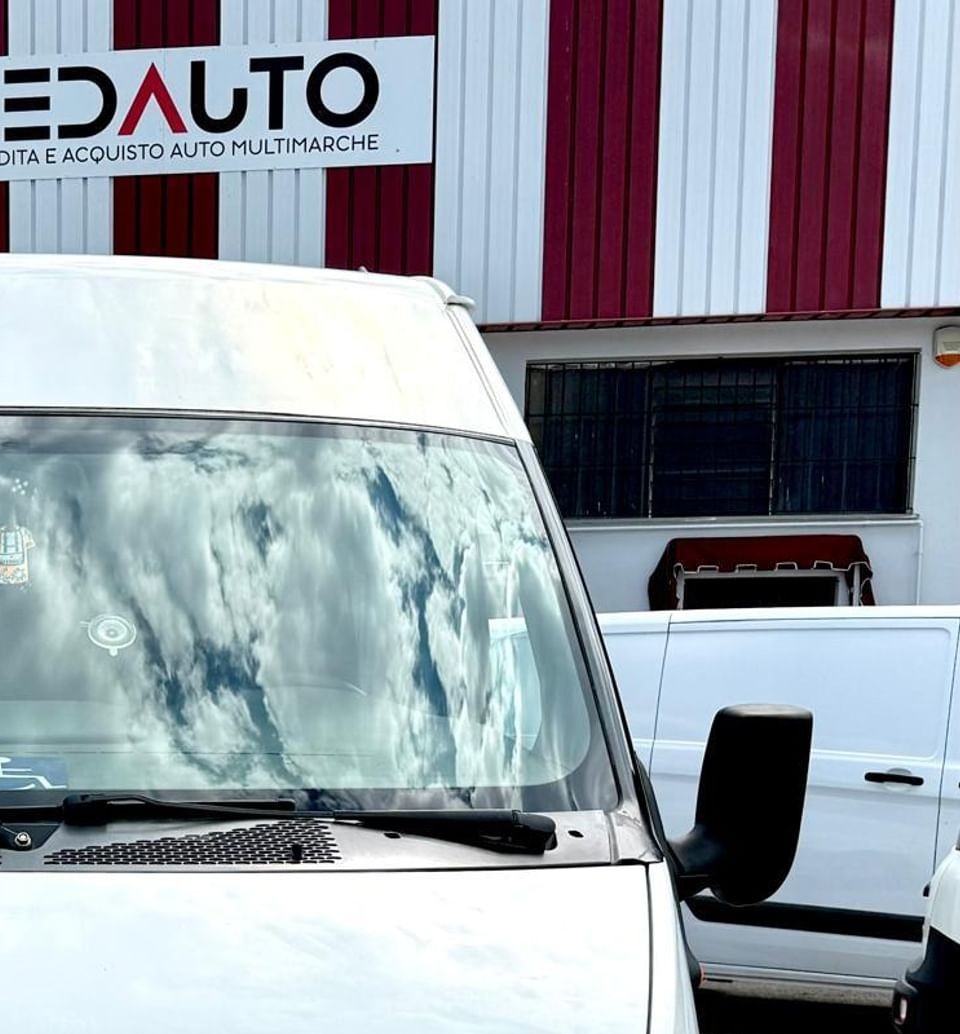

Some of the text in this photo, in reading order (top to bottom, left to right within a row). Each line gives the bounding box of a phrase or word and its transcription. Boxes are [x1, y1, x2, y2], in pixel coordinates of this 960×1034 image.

[45, 147, 56, 163] E
[62, 141, 165, 164] ACQUISTO
[170, 140, 224, 158] AUTO
[232, 133, 380, 155] MULTIMARCHE
